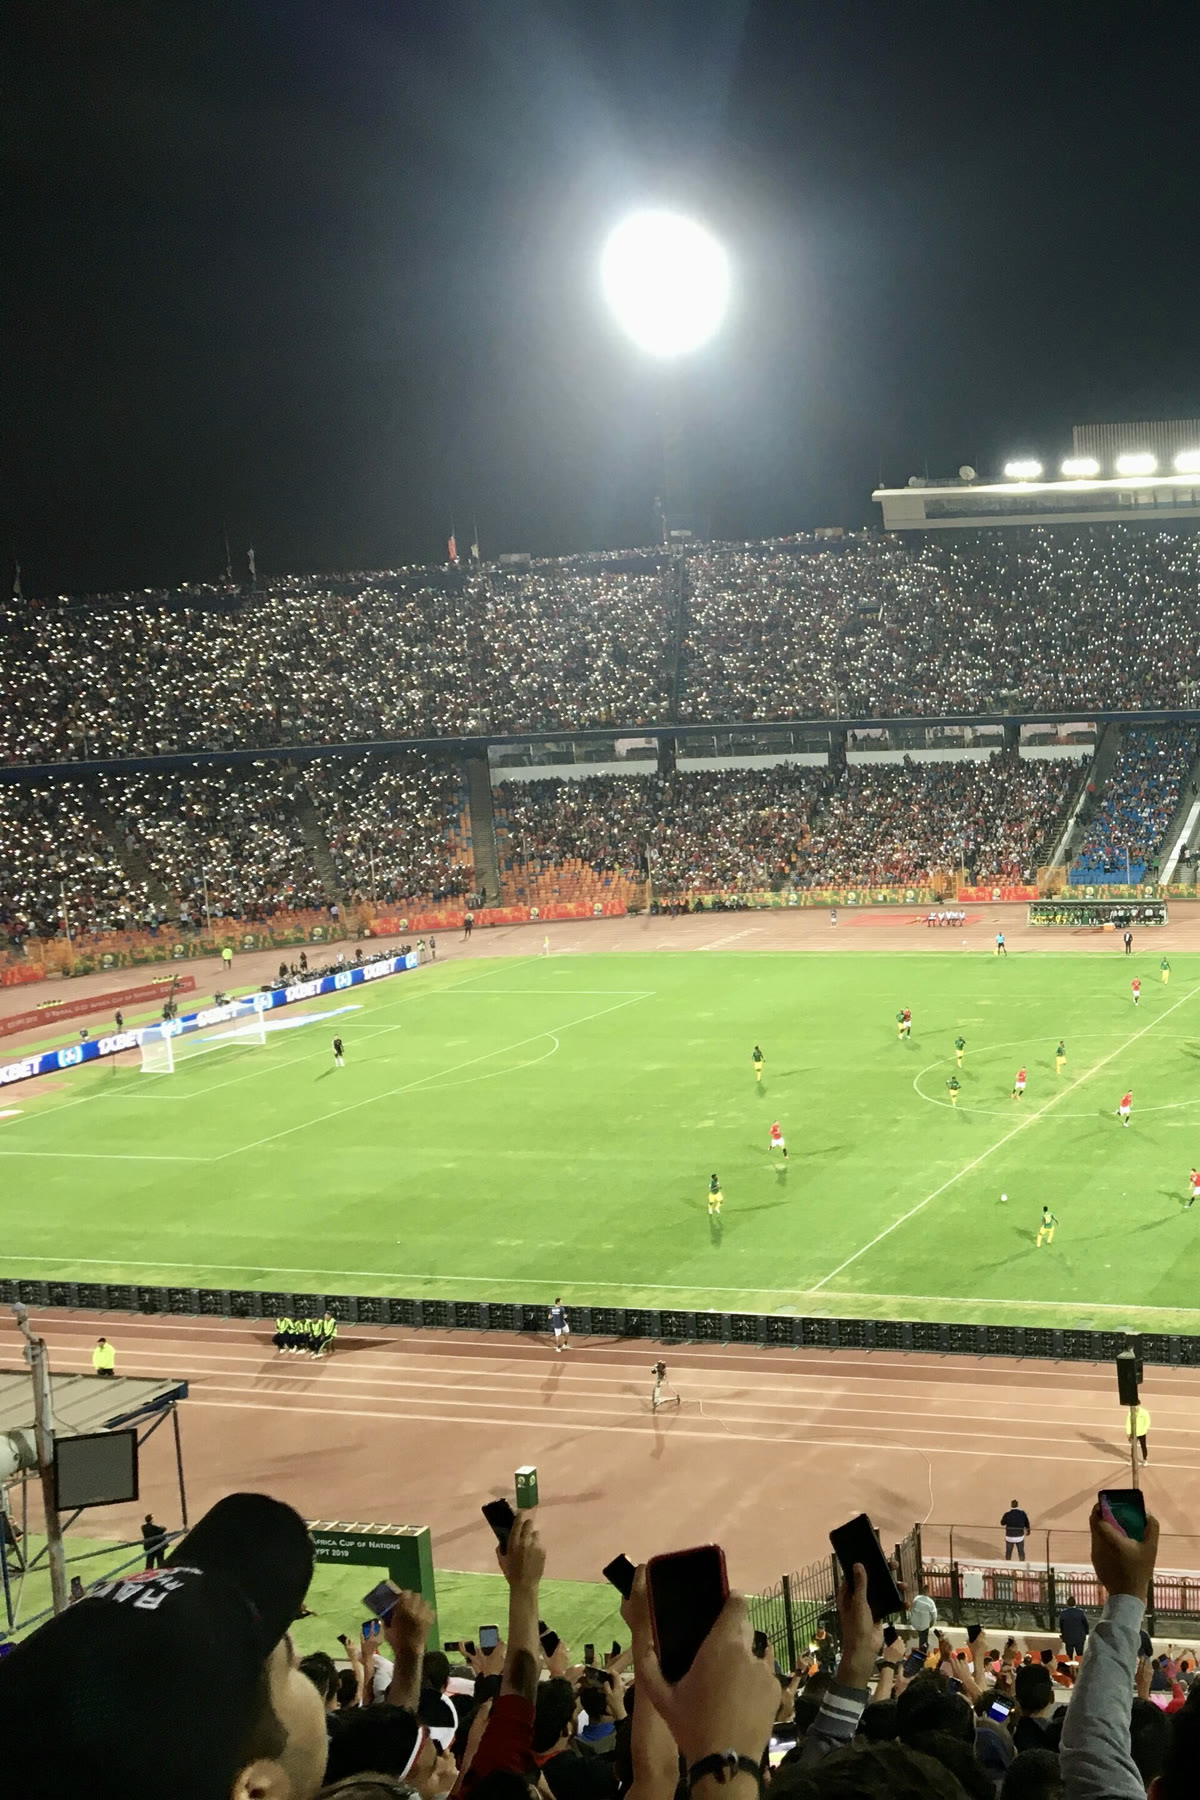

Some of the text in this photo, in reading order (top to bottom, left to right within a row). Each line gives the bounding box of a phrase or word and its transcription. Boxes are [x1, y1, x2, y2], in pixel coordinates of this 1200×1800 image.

[0, 1056, 42, 1084] XBET
[339, 1539, 355, 1547] CUP
[369, 1541, 401, 1550] NATIONS
[314, 1548, 349, 1557] YPT 2019
